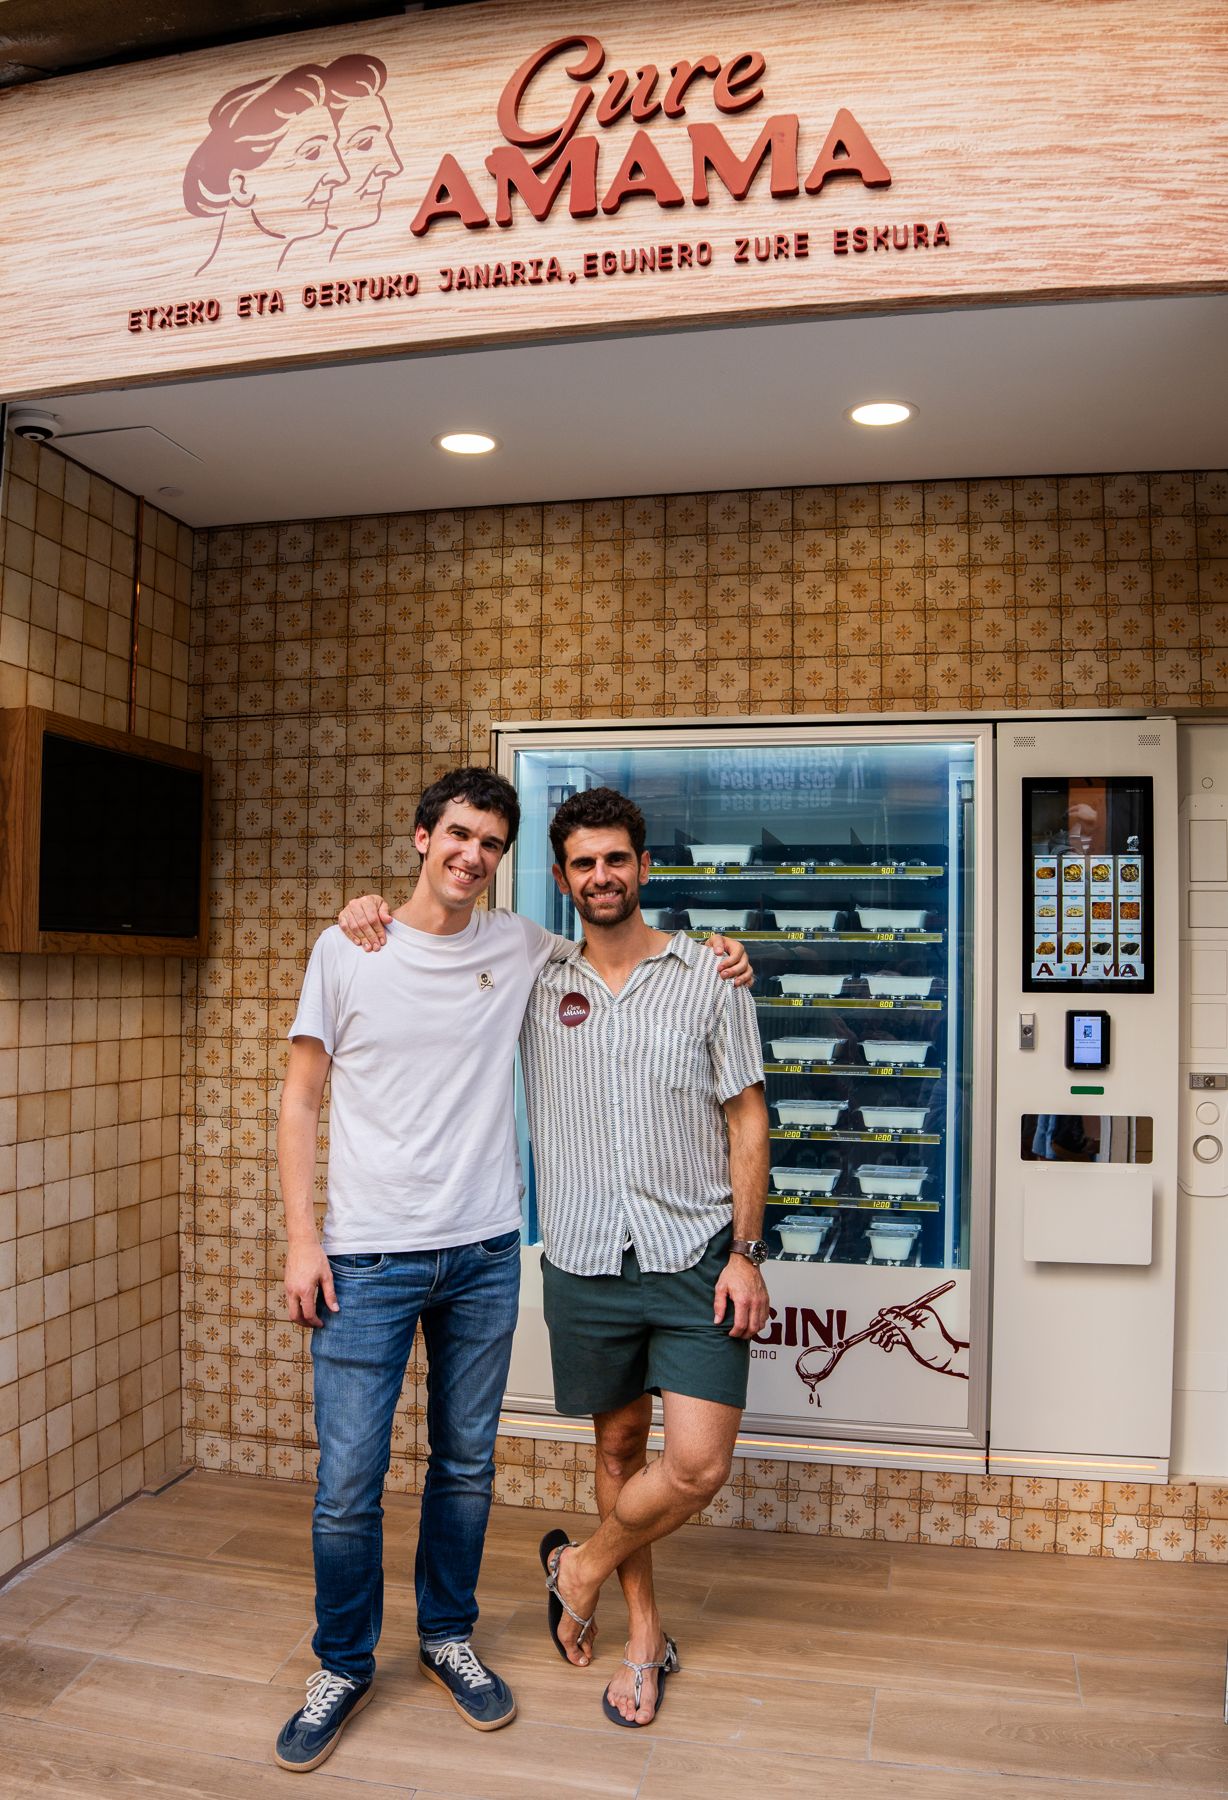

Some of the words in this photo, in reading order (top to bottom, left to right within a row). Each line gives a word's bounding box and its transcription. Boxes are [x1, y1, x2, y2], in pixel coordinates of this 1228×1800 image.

[485, 35, 766, 173] Gure
[410, 108, 892, 236] AMAMA
[128, 298, 220, 332] ETXEKO
[237, 289, 284, 317] ETA
[301, 272, 418, 308] GERTUKO
[583, 241, 712, 278] EGUNERO
[734, 231, 809, 263] ZURE
[833, 221, 950, 255] ESKURA
[750, 1349, 777, 1360] ama
[751, 1306, 847, 1349] GIN!
